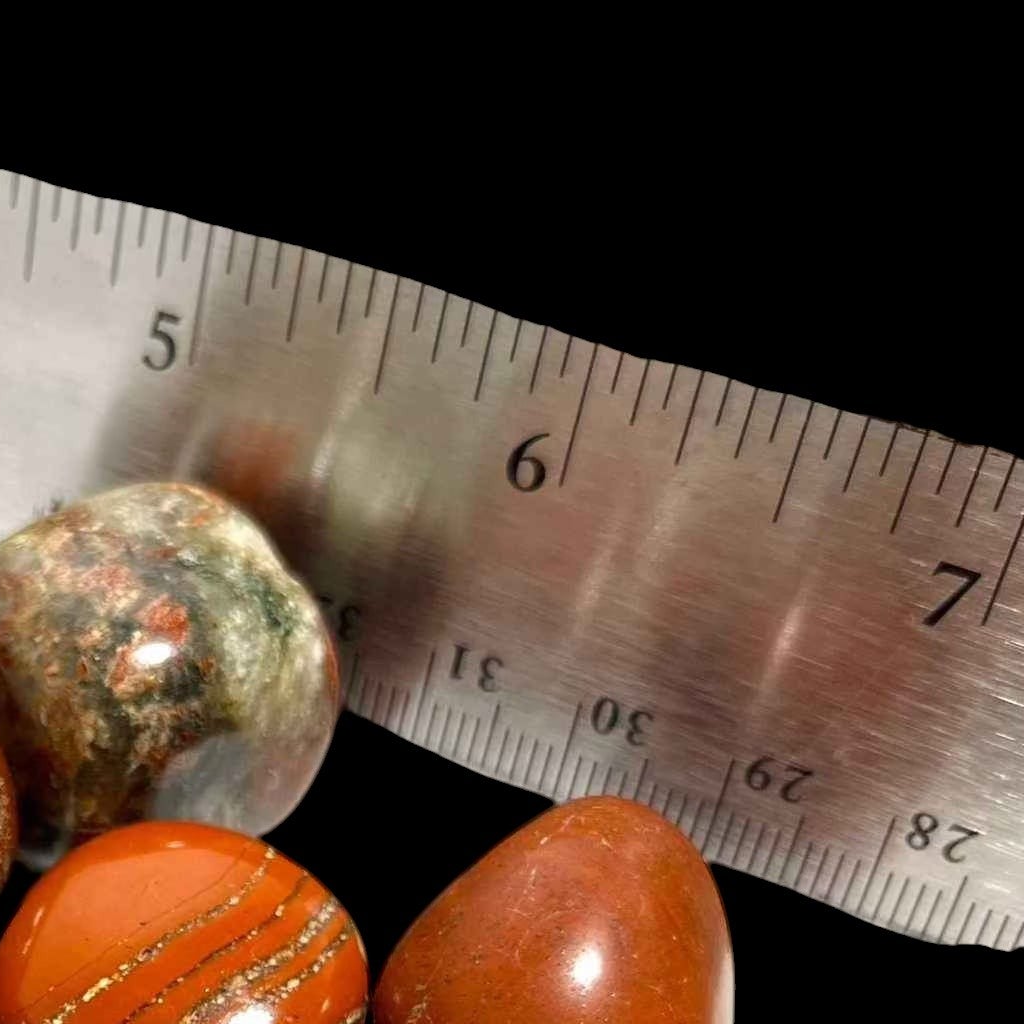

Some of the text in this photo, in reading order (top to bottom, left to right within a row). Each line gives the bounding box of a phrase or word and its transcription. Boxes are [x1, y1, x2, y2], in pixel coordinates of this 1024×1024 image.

[141, 311, 181, 371] 5
[506, 432, 551, 493] 6
[921, 560, 982, 627] 7
[449, 642, 505, 694] 31
[590, 696, 655, 747] 30
[744, 755, 814, 802] 29
[904, 811, 979, 864] 28
